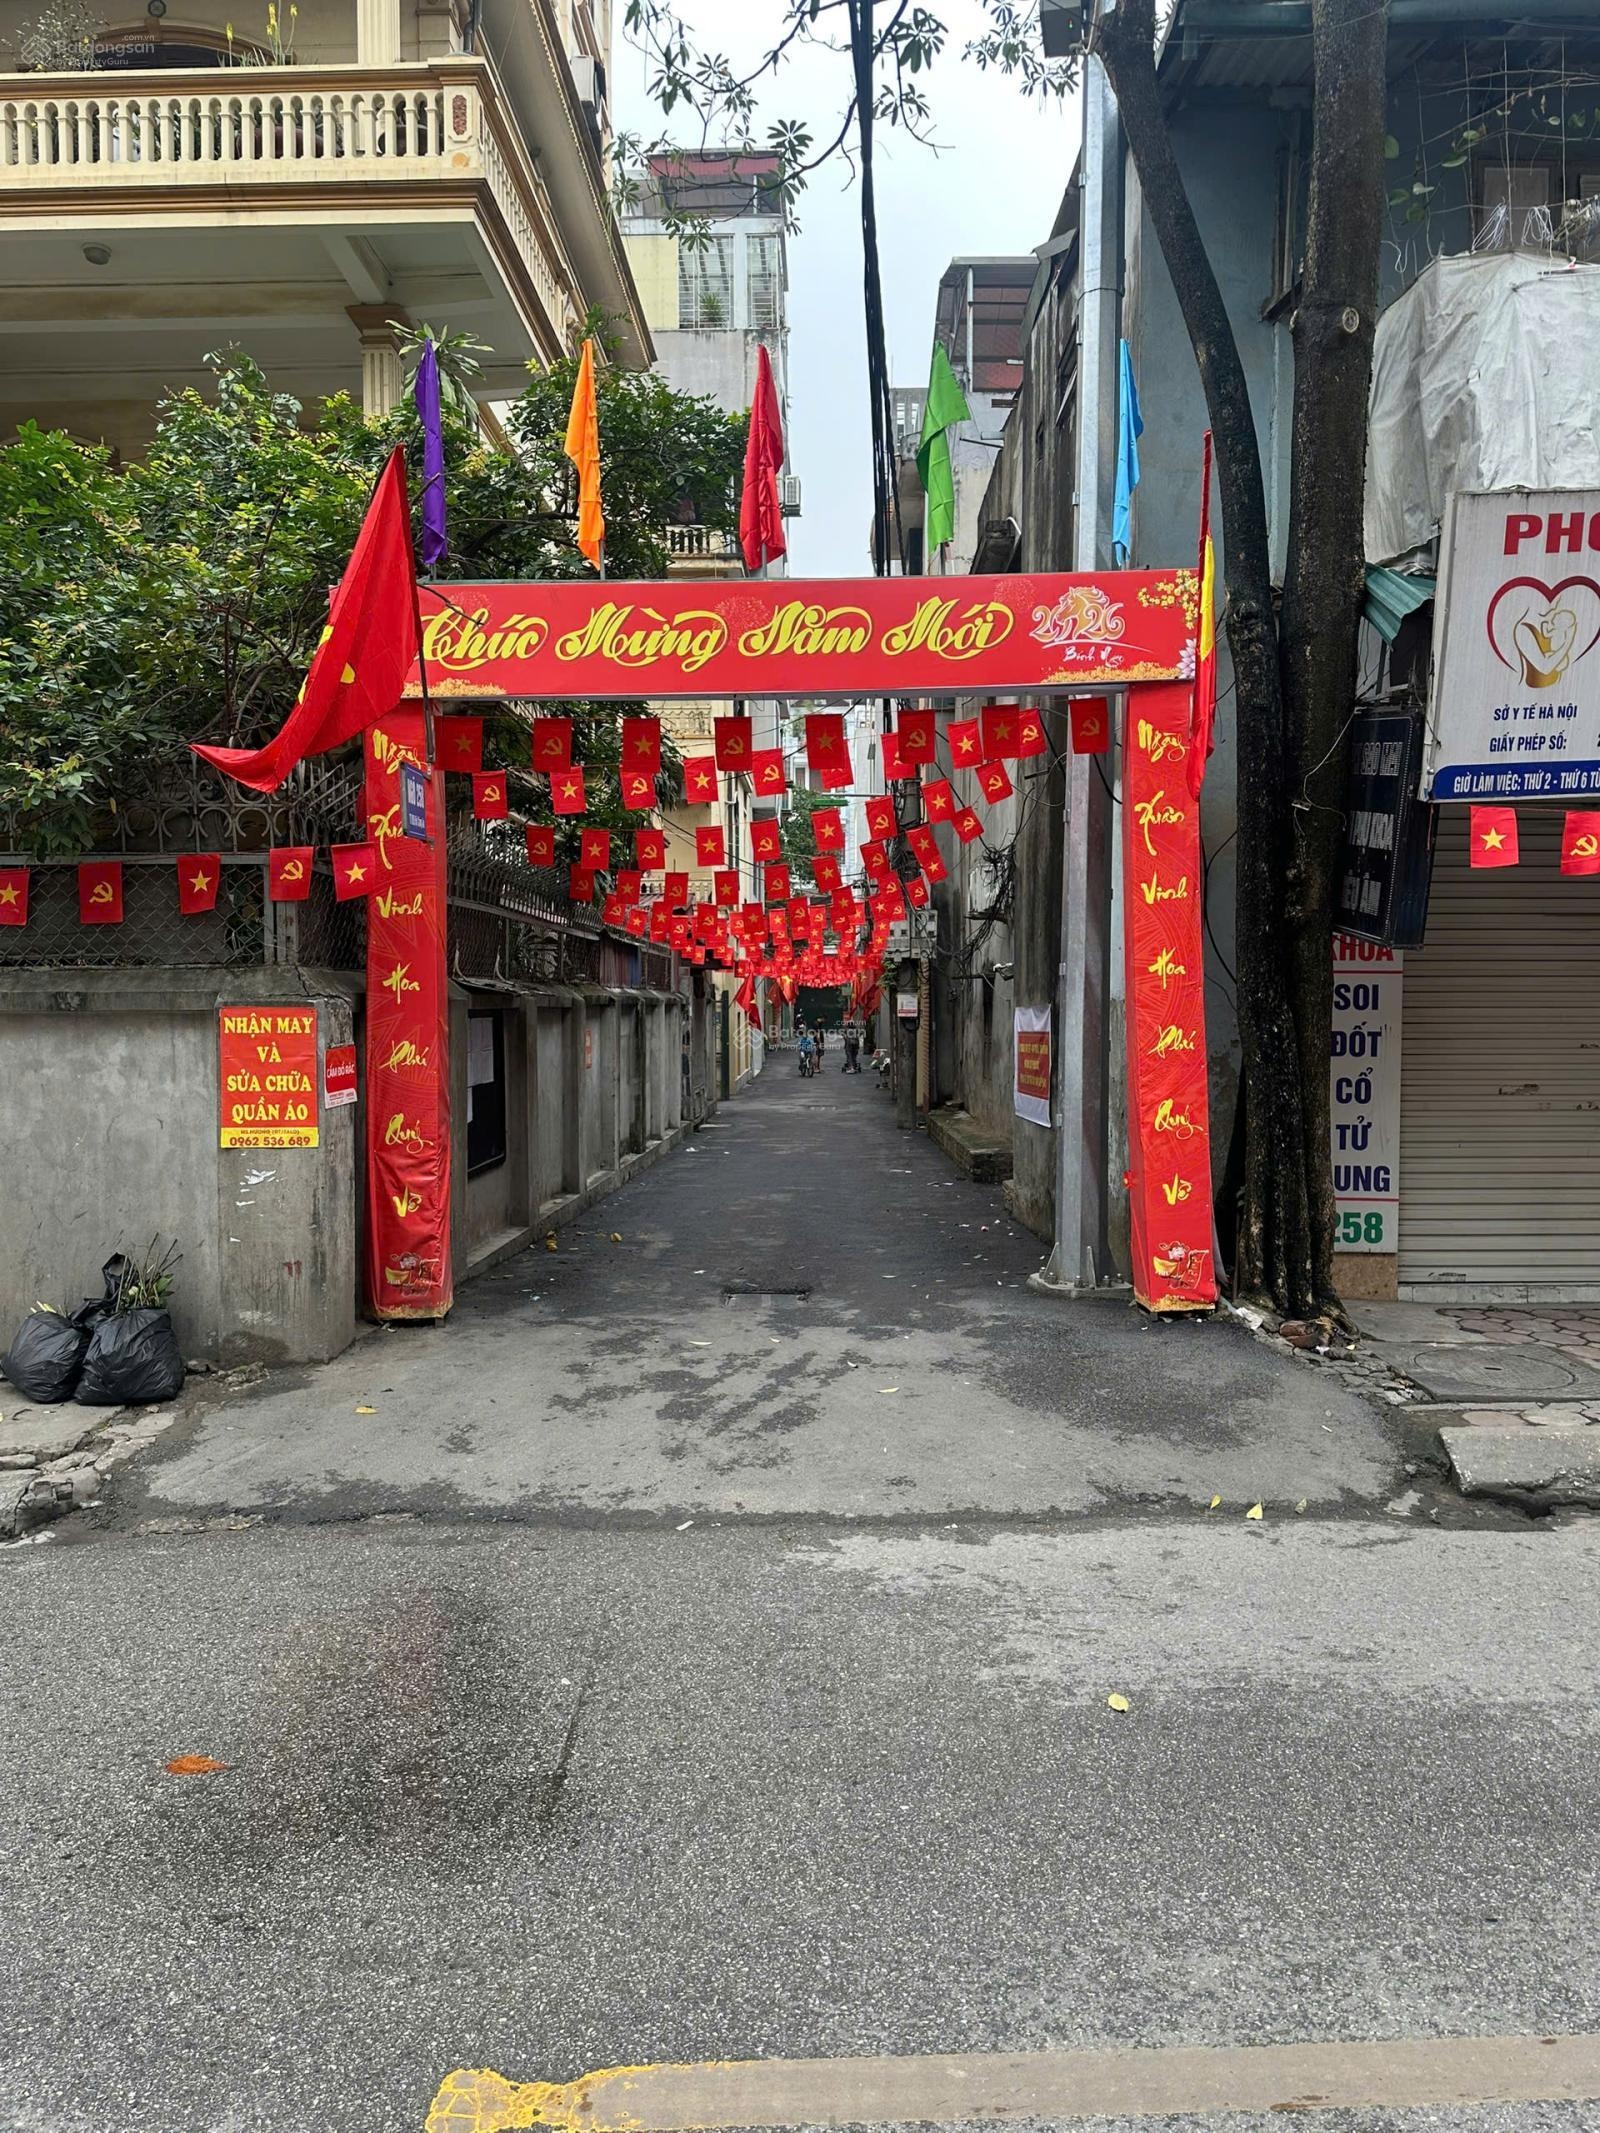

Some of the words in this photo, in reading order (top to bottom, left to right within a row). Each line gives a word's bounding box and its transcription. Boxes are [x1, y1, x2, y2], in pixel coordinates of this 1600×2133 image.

[420, 605, 548, 671] Chúc
[555, 601, 728, 673] Mừng
[738, 600, 874, 656] Năm
[881, 596, 1015, 661] Mới
[1493, 704, 1510, 721] SỞ
[1513, 707, 1520, 720] Y
[1523, 703, 1537, 720] TẾ
[1539, 704, 1554, 719] HÀ
[1557, 703, 1578, 720] NỘI
[1138, 719, 1189, 762] Ngày
[1489, 732, 1515, 753] GIẤY
[1517, 733, 1546, 751] PHÉP
[1549, 730, 1567, 750] SỐ:
[1454, 772, 1471, 793] GIỜ
[1472, 773, 1494, 792] LÀM
[1497, 771, 1521, 794] VIỆC:
[1524, 770, 1545, 791] THỨ
[1544, 773, 1552, 788] 2
[1560, 768, 1580, 789] THỨ
[1580, 771, 1588, 789] 6
[369, 803, 405, 870] Xu
[1134, 791, 1184, 856] Xuân
[376, 885, 423, 918] Vinh
[1141, 871, 1187, 904] Vinh
[382, 961, 420, 1004] Hoa
[1148, 947, 1186, 989] Hoa
[1334, 984, 1379, 1010] SOI
[224, 1013, 272, 1038] NHẬN
[277, 1017, 313, 1034] MAY
[1148, 1024, 1195, 1058] Phú
[1330, 1021, 1382, 1057] ĐỐT
[256, 1042, 282, 1063] VÀ
[379, 1040, 427, 1073] Phú
[227, 1069, 261, 1092] SỬA
[265, 1071, 312, 1092] CHỮA
[1336, 1067, 1373, 1104] CỔ
[232, 1096, 280, 1124] QUẦN
[284, 1100, 308, 1120] ÁO
[1155, 1098, 1203, 1139] Quý
[230, 1137, 259, 1146] 0962
[263, 1137, 285, 1146] 536
[288, 1136, 310, 1146] 689
[384, 1113, 433, 1154] Quý
[1336, 1115, 1372, 1151] TỬ
[1335, 1165, 1390, 1192] UNG
